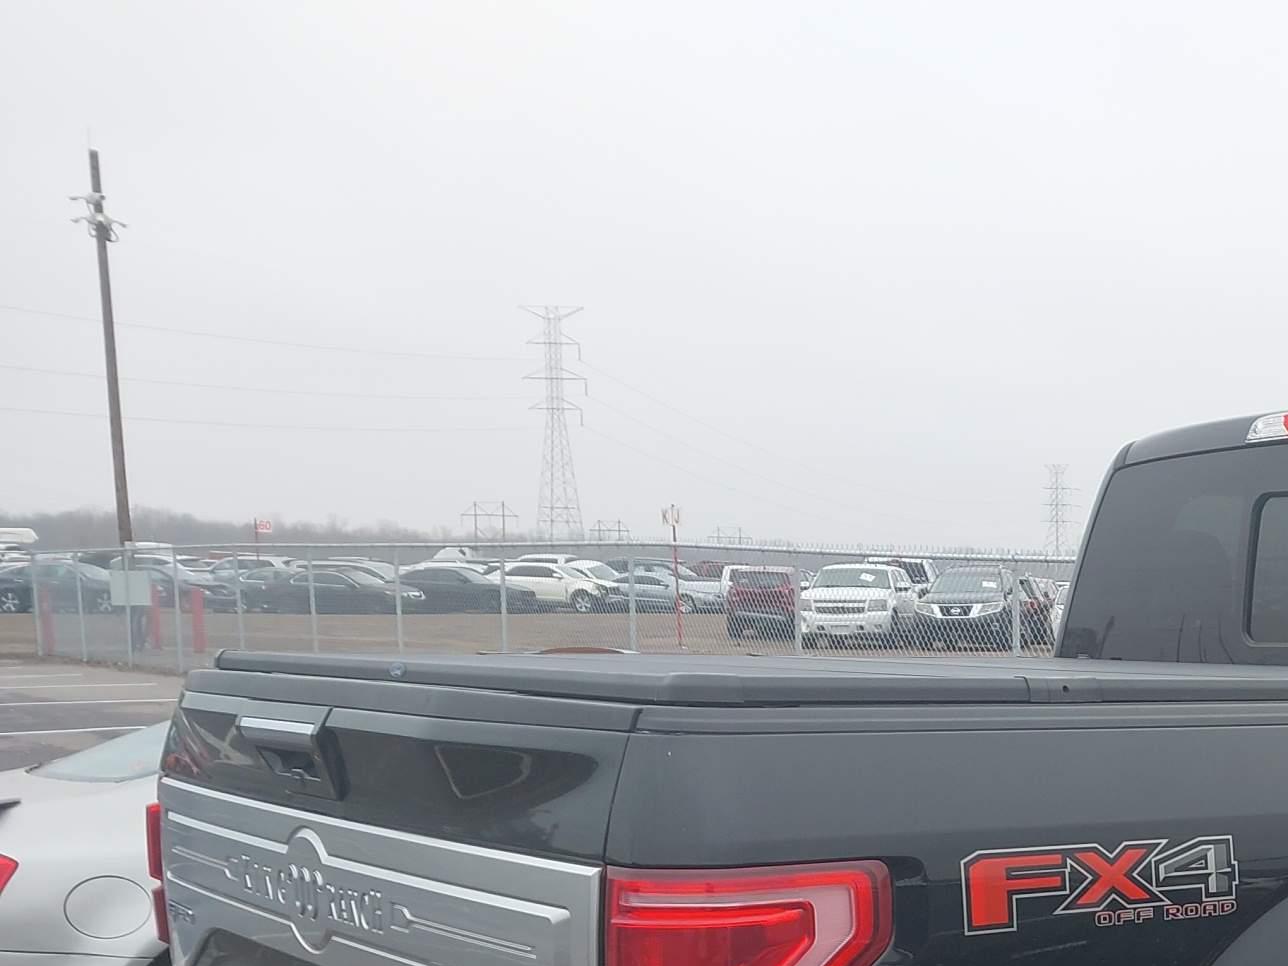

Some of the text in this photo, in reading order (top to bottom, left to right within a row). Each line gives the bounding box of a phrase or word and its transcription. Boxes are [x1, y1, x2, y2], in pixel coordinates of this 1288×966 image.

[960, 835, 1238, 936] FX4
[1095, 900, 1237, 927] OFF ROAD
